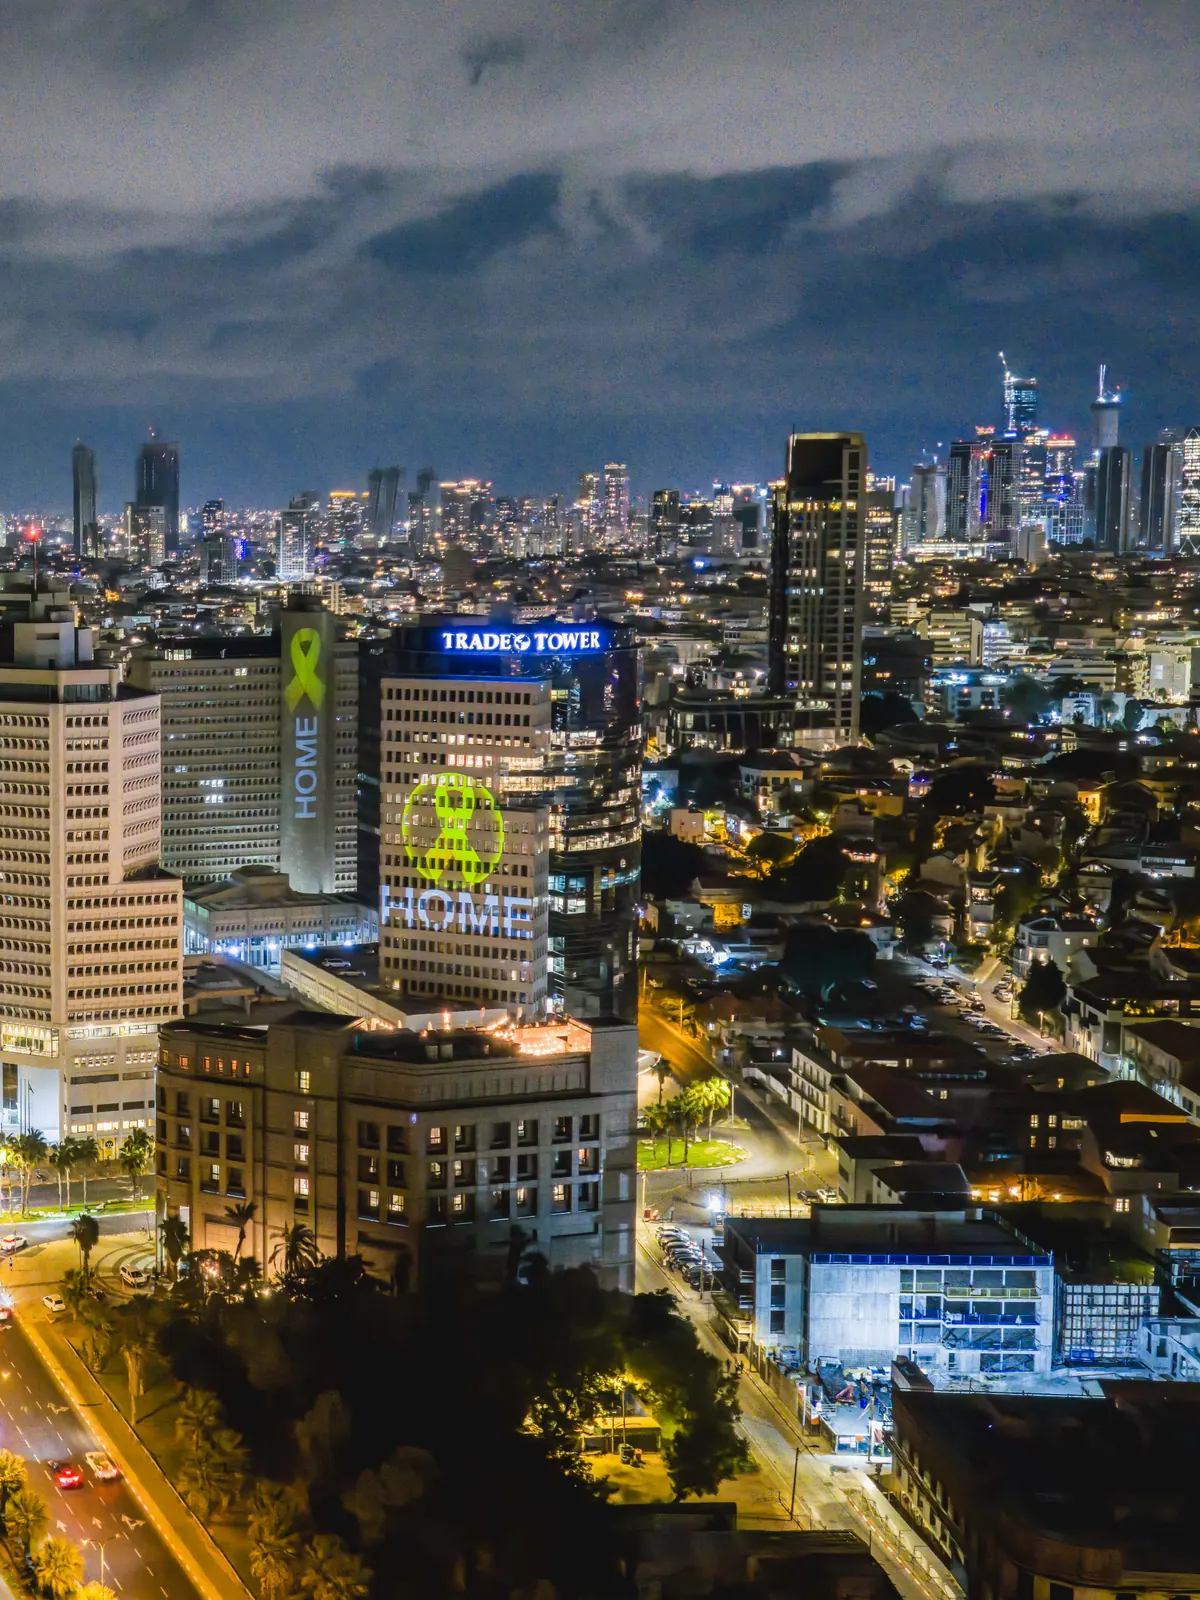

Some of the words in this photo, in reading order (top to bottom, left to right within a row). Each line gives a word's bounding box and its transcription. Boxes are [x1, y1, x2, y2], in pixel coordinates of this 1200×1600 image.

[442, 632, 512, 651] TRADE
[534, 631, 601, 650] TOWER
[295, 716, 318, 819] HOME
[380, 884, 534, 938] HOME
